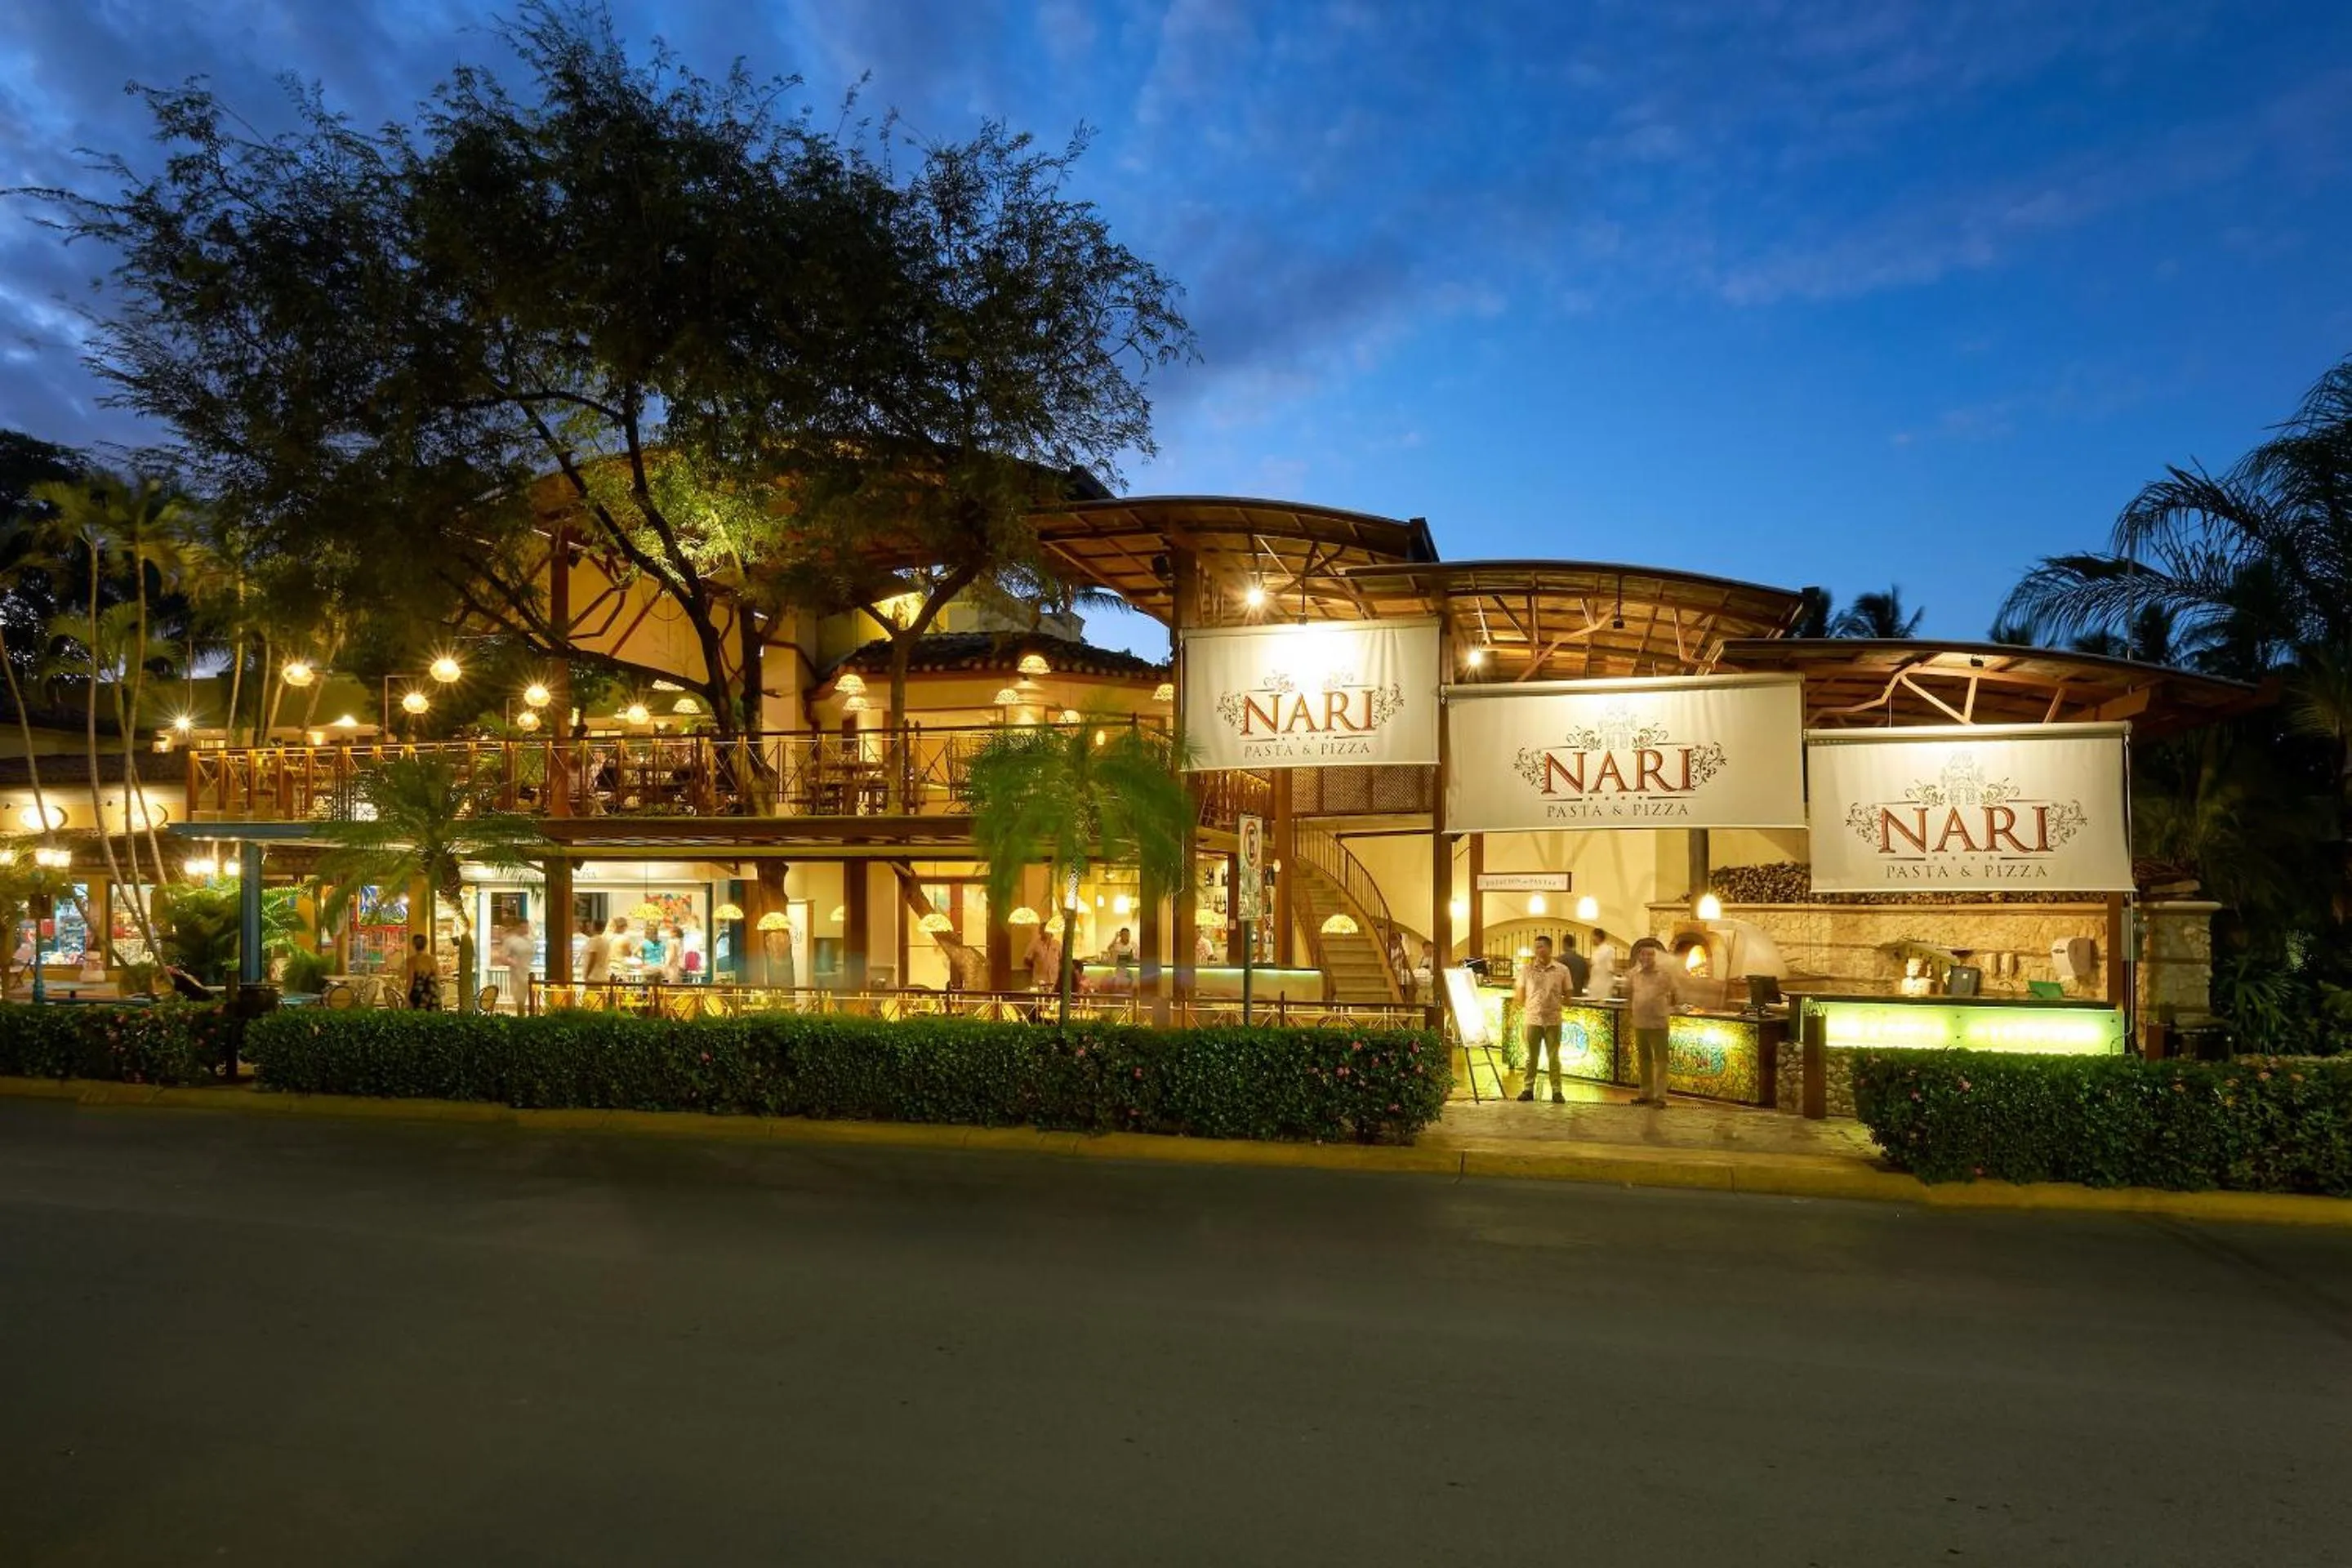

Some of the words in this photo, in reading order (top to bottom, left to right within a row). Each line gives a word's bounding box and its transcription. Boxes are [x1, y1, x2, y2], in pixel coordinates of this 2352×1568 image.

[1240, 690, 1376, 735] NARI
[1245, 743, 1294, 758] PASTA
[1302, 744, 1312, 755] &
[1321, 742, 1371, 755] PIZZA
[1540, 748, 1696, 794] NARI
[1547, 804, 1602, 817] PASTA
[1612, 805, 1622, 816] &
[1633, 803, 1689, 816] PIZZA
[1878, 806, 2054, 853] NARI
[1886, 865, 1949, 878] PASTA
[1959, 866, 1973, 878] &
[1984, 865, 2048, 878] PIZZA
